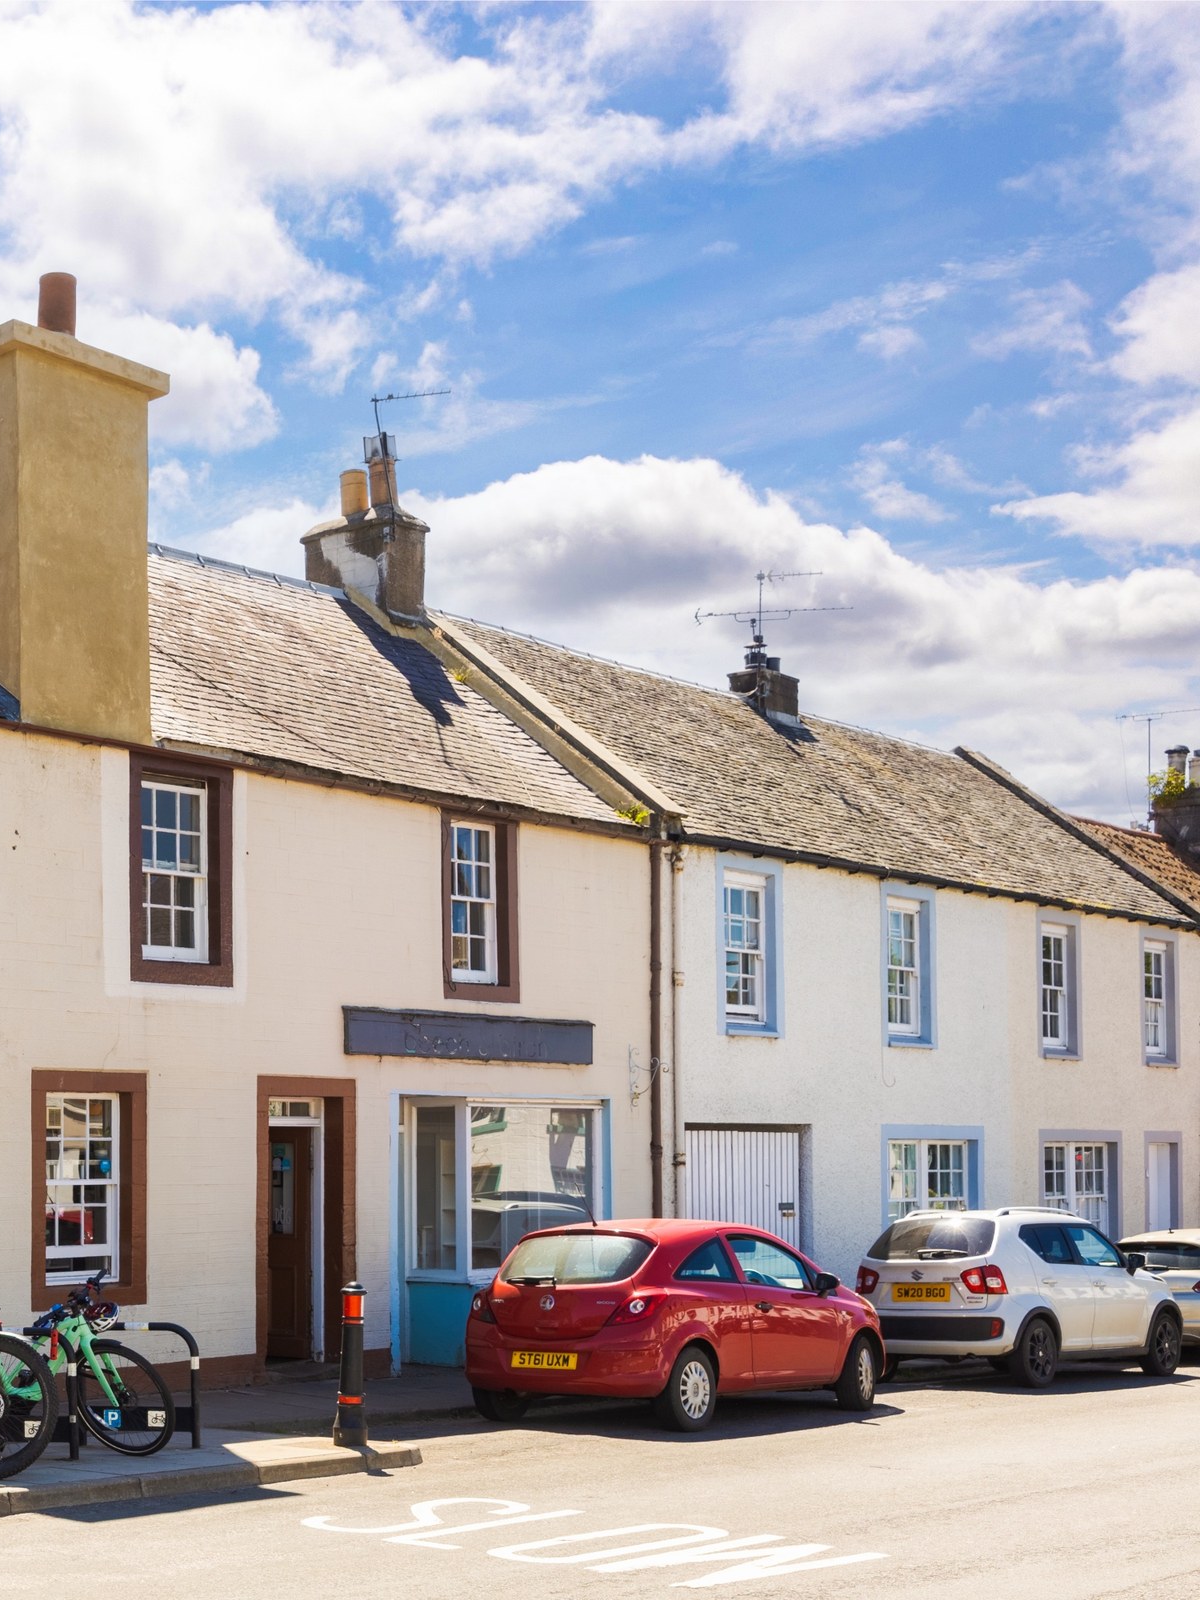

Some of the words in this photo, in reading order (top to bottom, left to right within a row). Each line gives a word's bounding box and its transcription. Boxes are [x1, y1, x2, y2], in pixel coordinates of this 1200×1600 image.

[897, 1288, 922, 1298] SW20
[519, 1353, 544, 1366] ST61
[547, 1354, 570, 1367] UXM
[107, 1412, 119, 1424] P
[300, 1497, 892, 1589] SLOW
